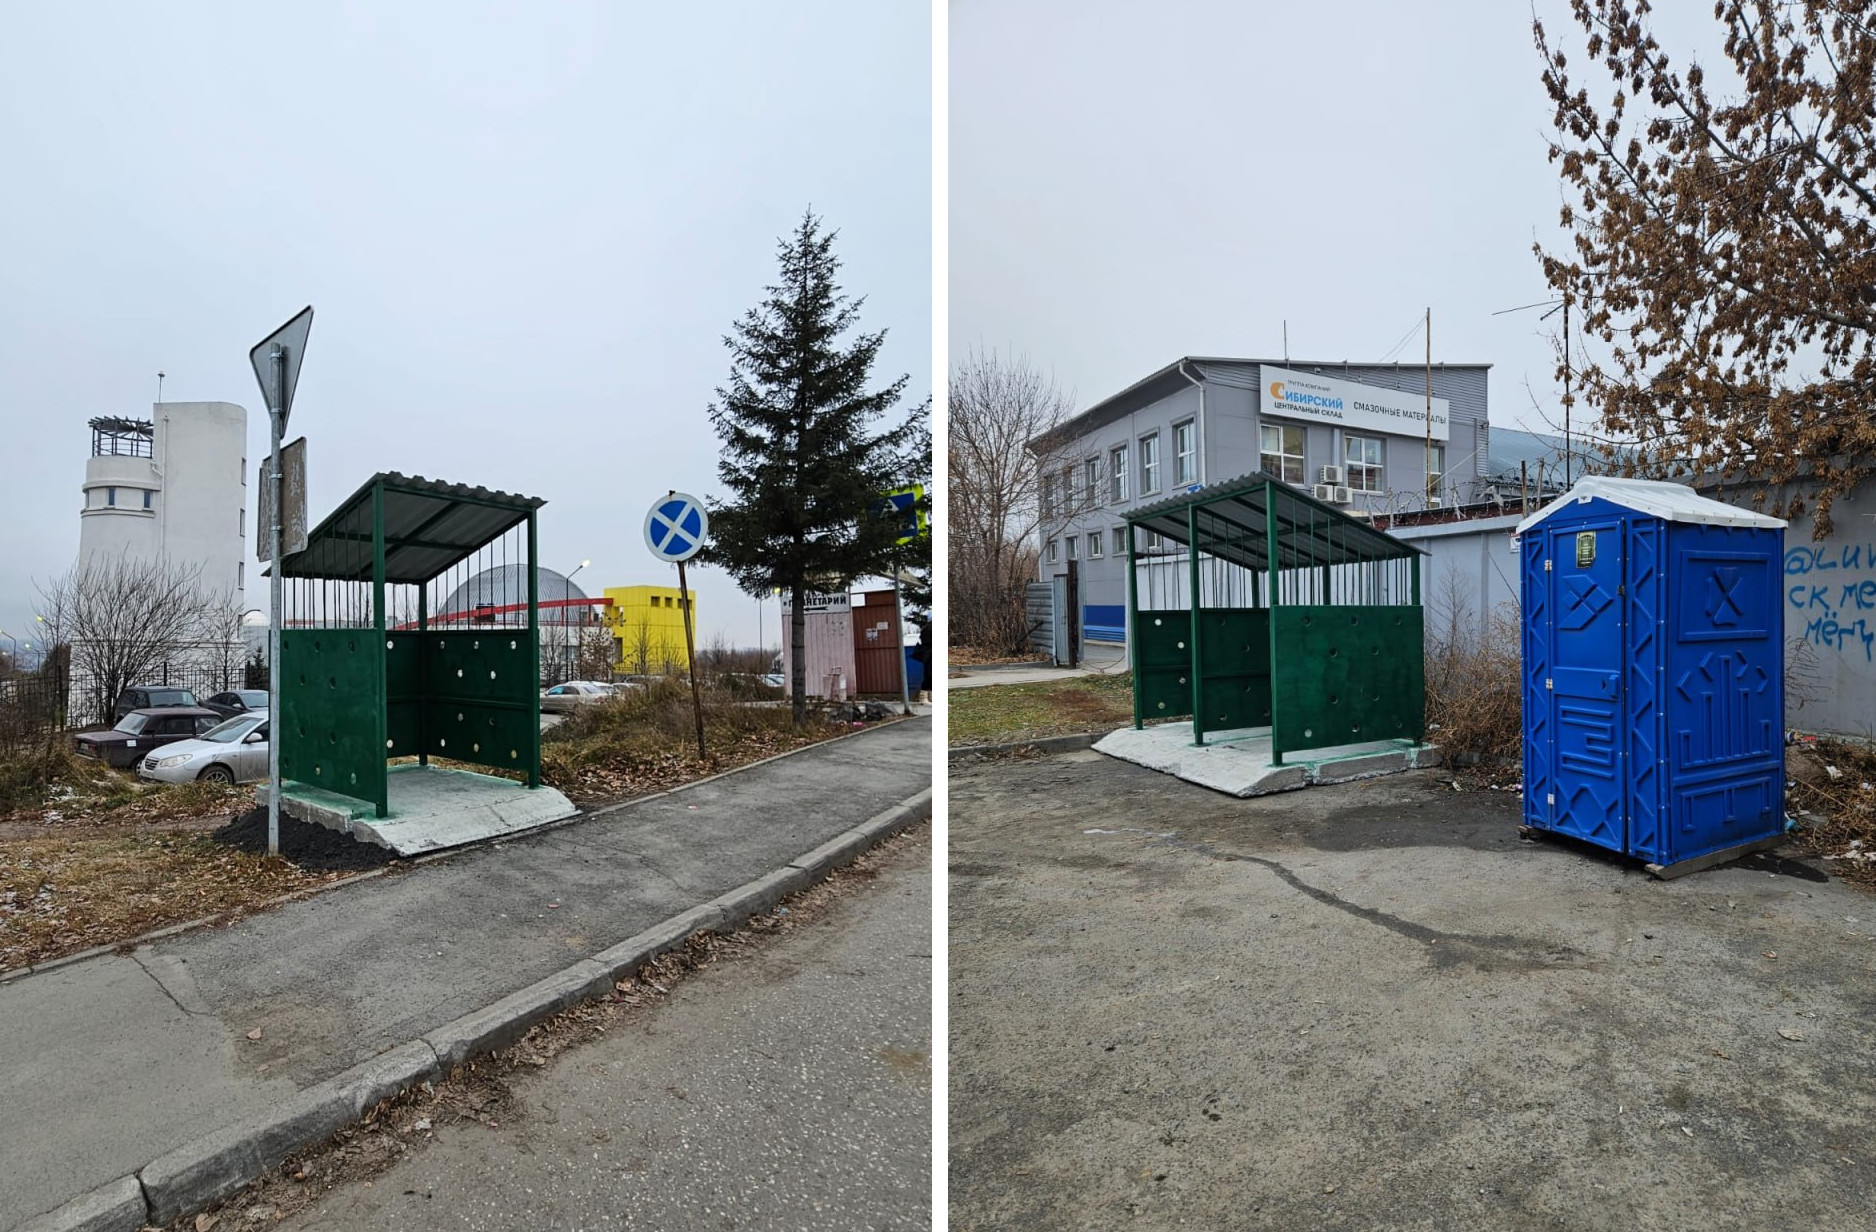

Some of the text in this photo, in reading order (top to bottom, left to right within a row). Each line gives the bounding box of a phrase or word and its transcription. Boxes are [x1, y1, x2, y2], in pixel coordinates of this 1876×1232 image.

[1270, 381, 1343, 410] СИБИРСКИЙ
[1275, 401, 1343, 419] ЦЕНТРАЛЬНЫЙ СКЛАД
[1353, 401, 1401, 417] СМАЗОЧНЫЕ
